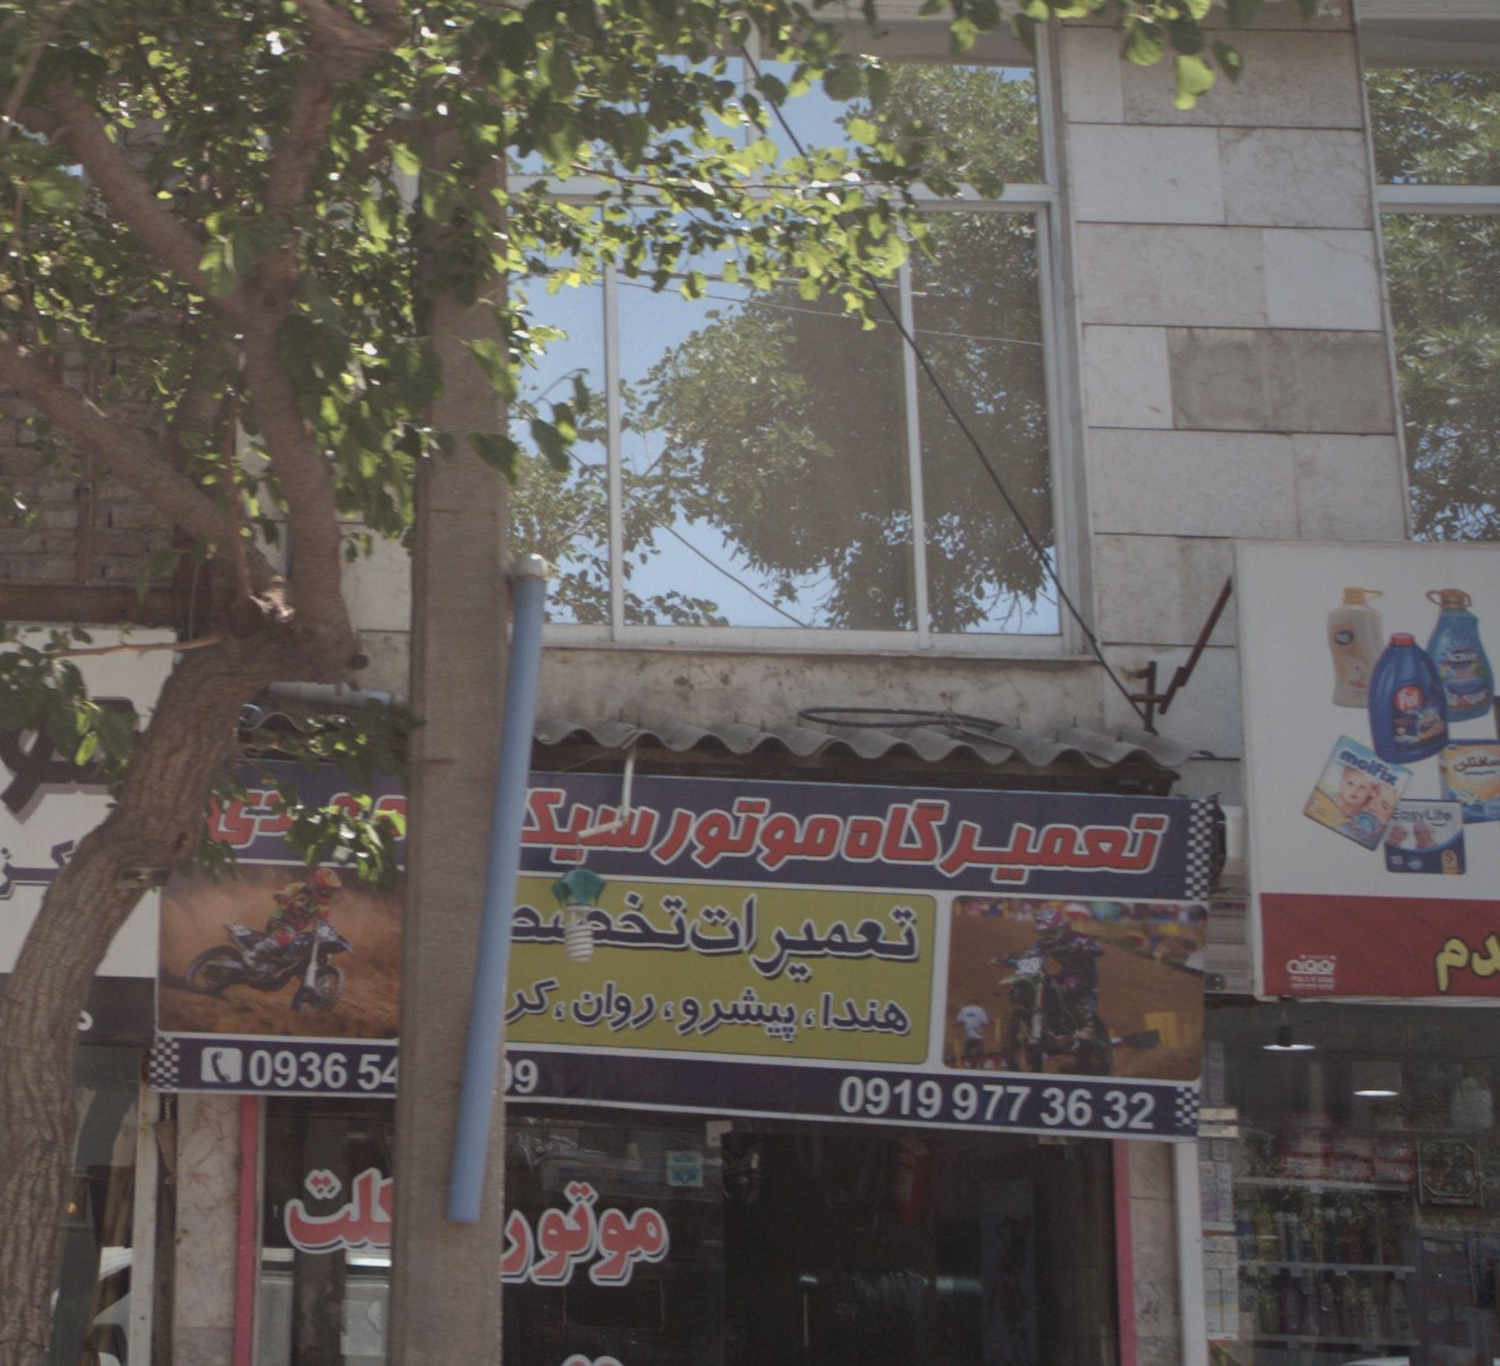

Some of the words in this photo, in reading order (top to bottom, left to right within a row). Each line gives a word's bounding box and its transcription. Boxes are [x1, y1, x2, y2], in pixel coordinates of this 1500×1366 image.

[1338, 749, 1398, 786] molfix
[842, 798, 1170, 884] تعمیرگاه
[510, 892, 688, 948] تخصص
[689, 892, 921, 980] تعمیرات
[248, 1049, 349, 1090] 0936
[839, 1075, 943, 1119] 0919
[952, 1082, 1031, 1122] 977
[1040, 1087, 1093, 1127] 36
[1102, 1090, 1156, 1130] 32
